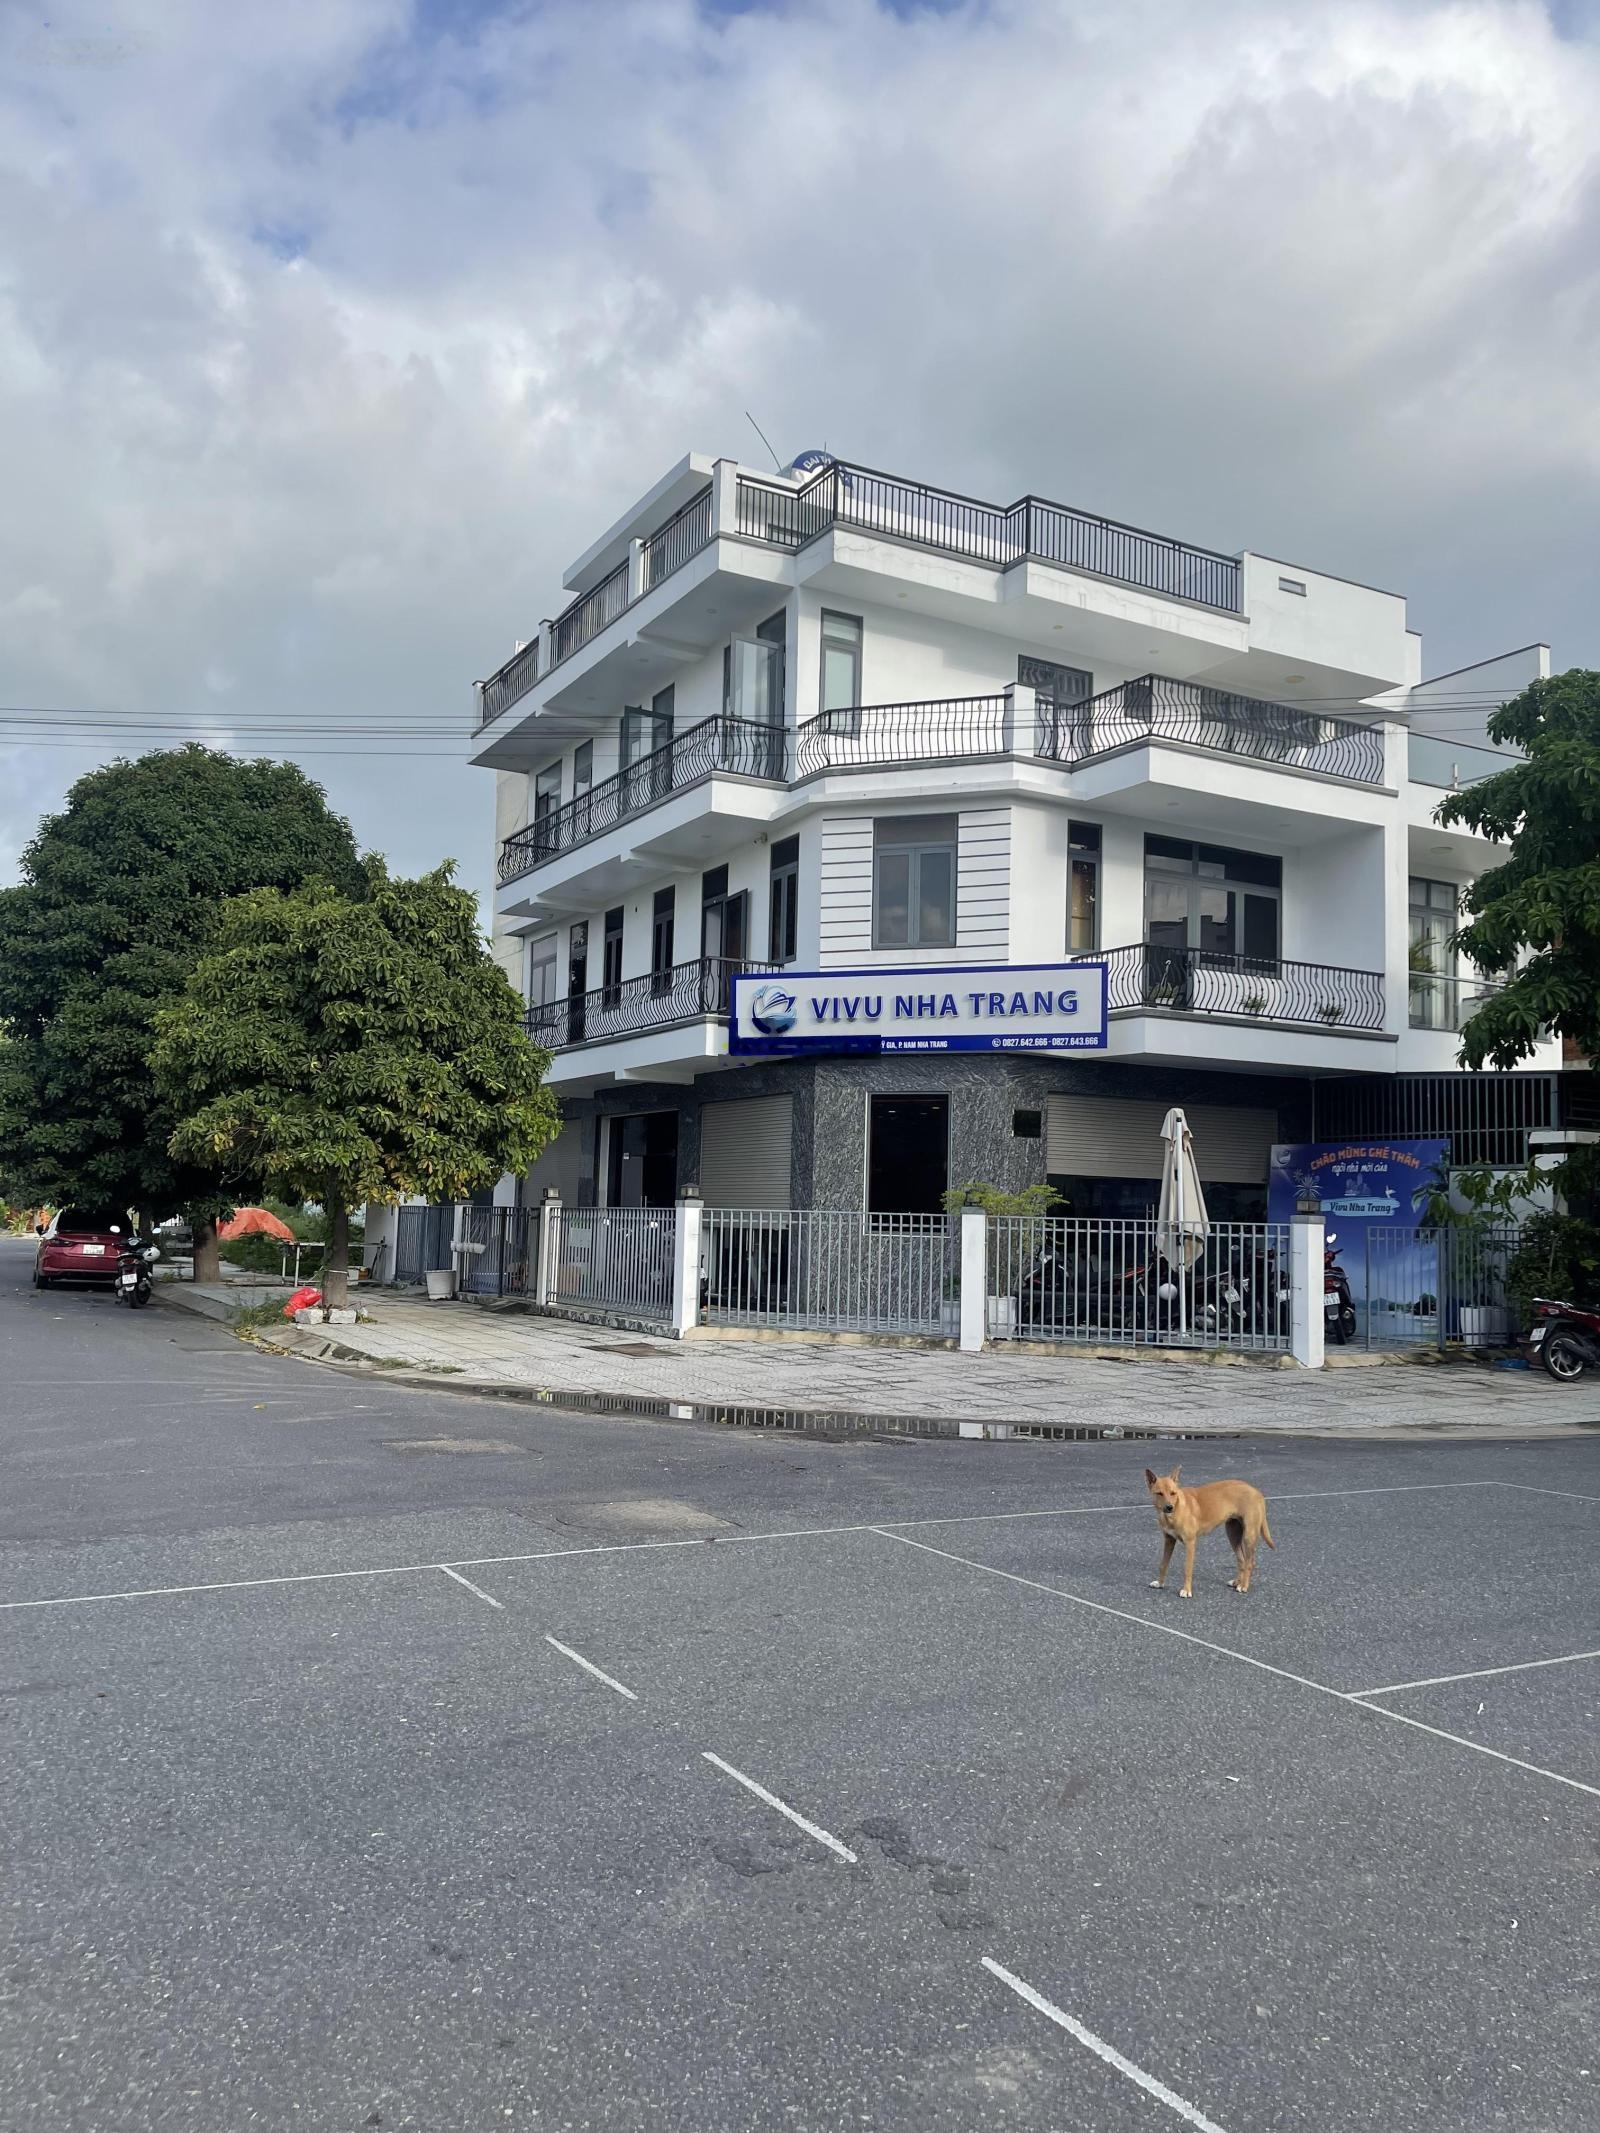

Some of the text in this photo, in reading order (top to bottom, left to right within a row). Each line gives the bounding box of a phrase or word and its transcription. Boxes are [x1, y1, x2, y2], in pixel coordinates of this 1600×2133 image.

[811, 990, 1078, 1019] VIVU NHA TRANG
[904, 1041, 916, 1049] NAM
[930, 1040, 948, 1048] TRANG
[1330, 1202, 1391, 1214] Vivu Nha Trang
